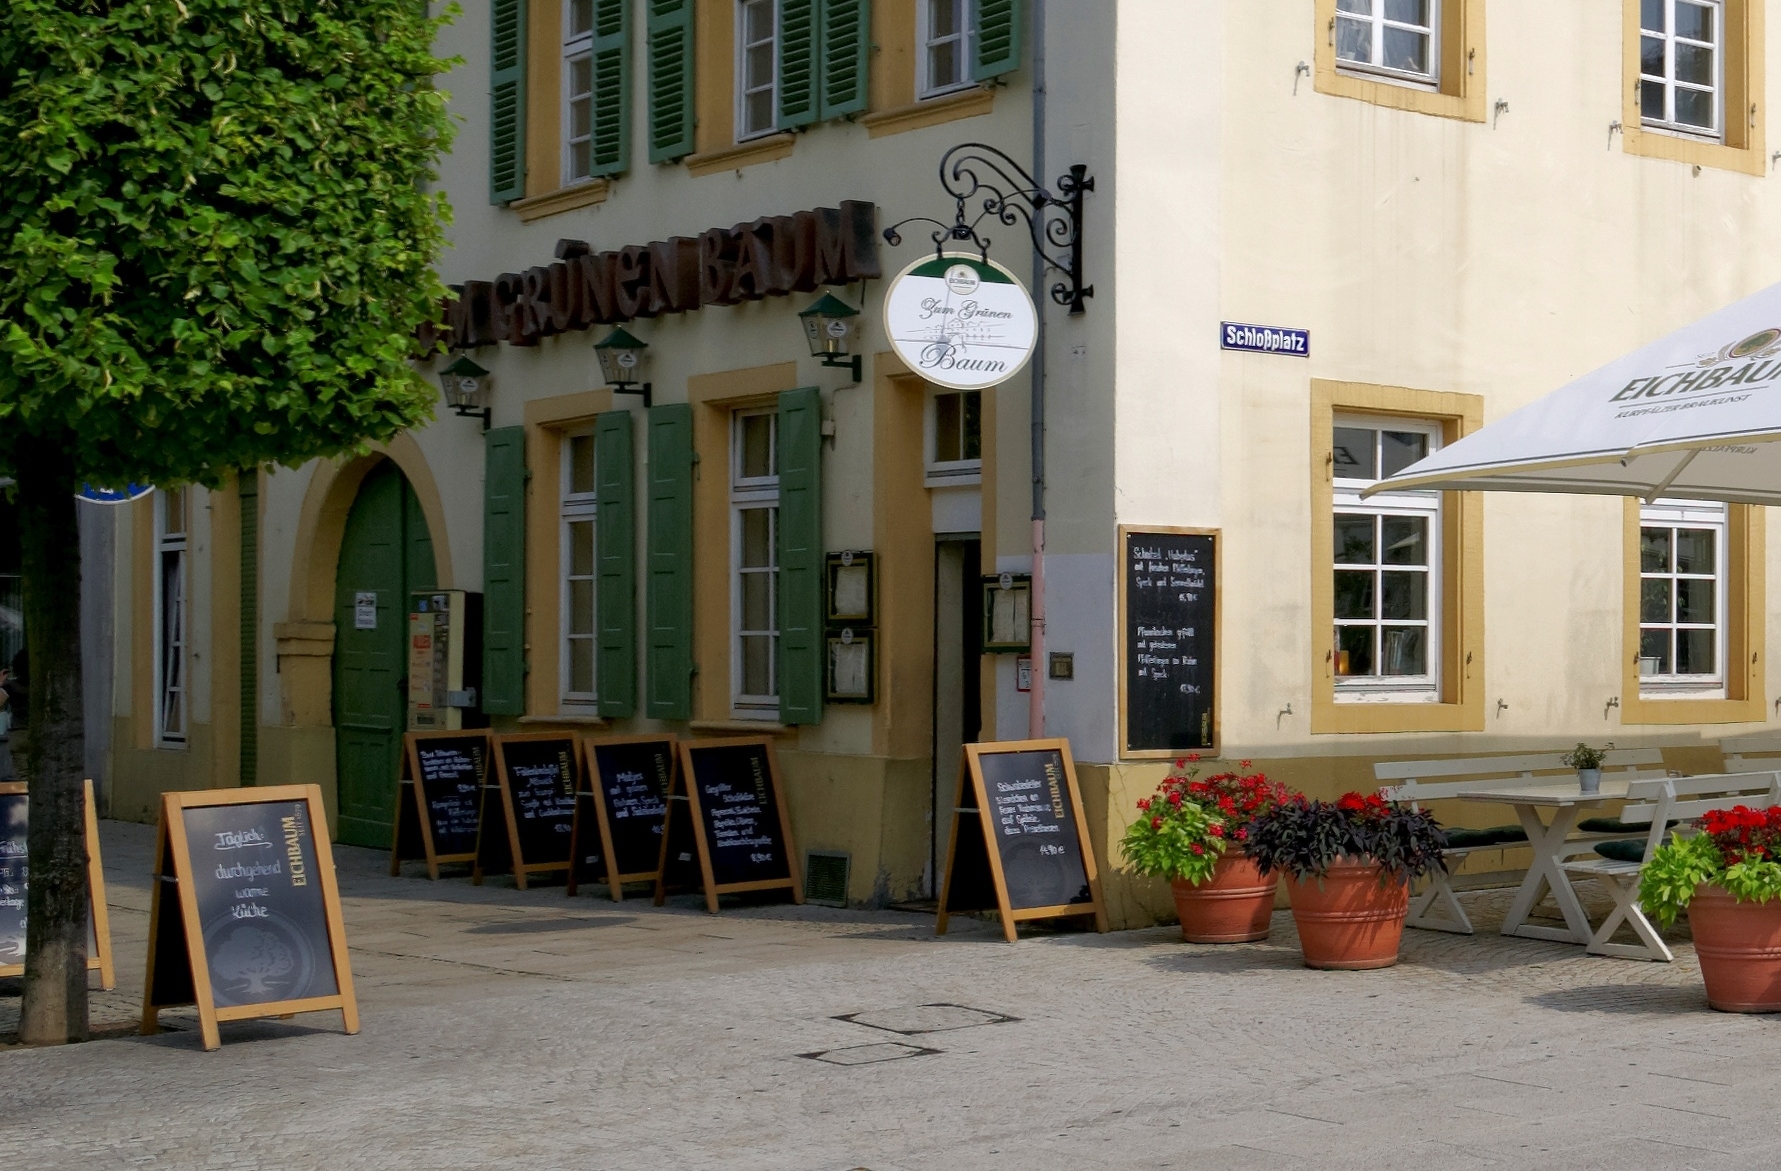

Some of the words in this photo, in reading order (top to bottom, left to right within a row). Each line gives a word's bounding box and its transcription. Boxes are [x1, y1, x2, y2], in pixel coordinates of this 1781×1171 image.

[700, 199, 881, 306] BAUM
[919, 297, 955, 320] Zum
[957, 299, 1013, 320] Grünen
[1226, 325, 1306, 351] Schloßplatz
[919, 342, 1008, 373] Baum
[750, 756, 768, 805] EICHBAUM
[1044, 763, 1065, 819] EICHBAUM
[280, 816, 307, 887] EICHBAUM
[215, 859, 282, 882] durchgehend
[235, 887, 270, 899] warme
[231, 902, 269, 919] Küche
